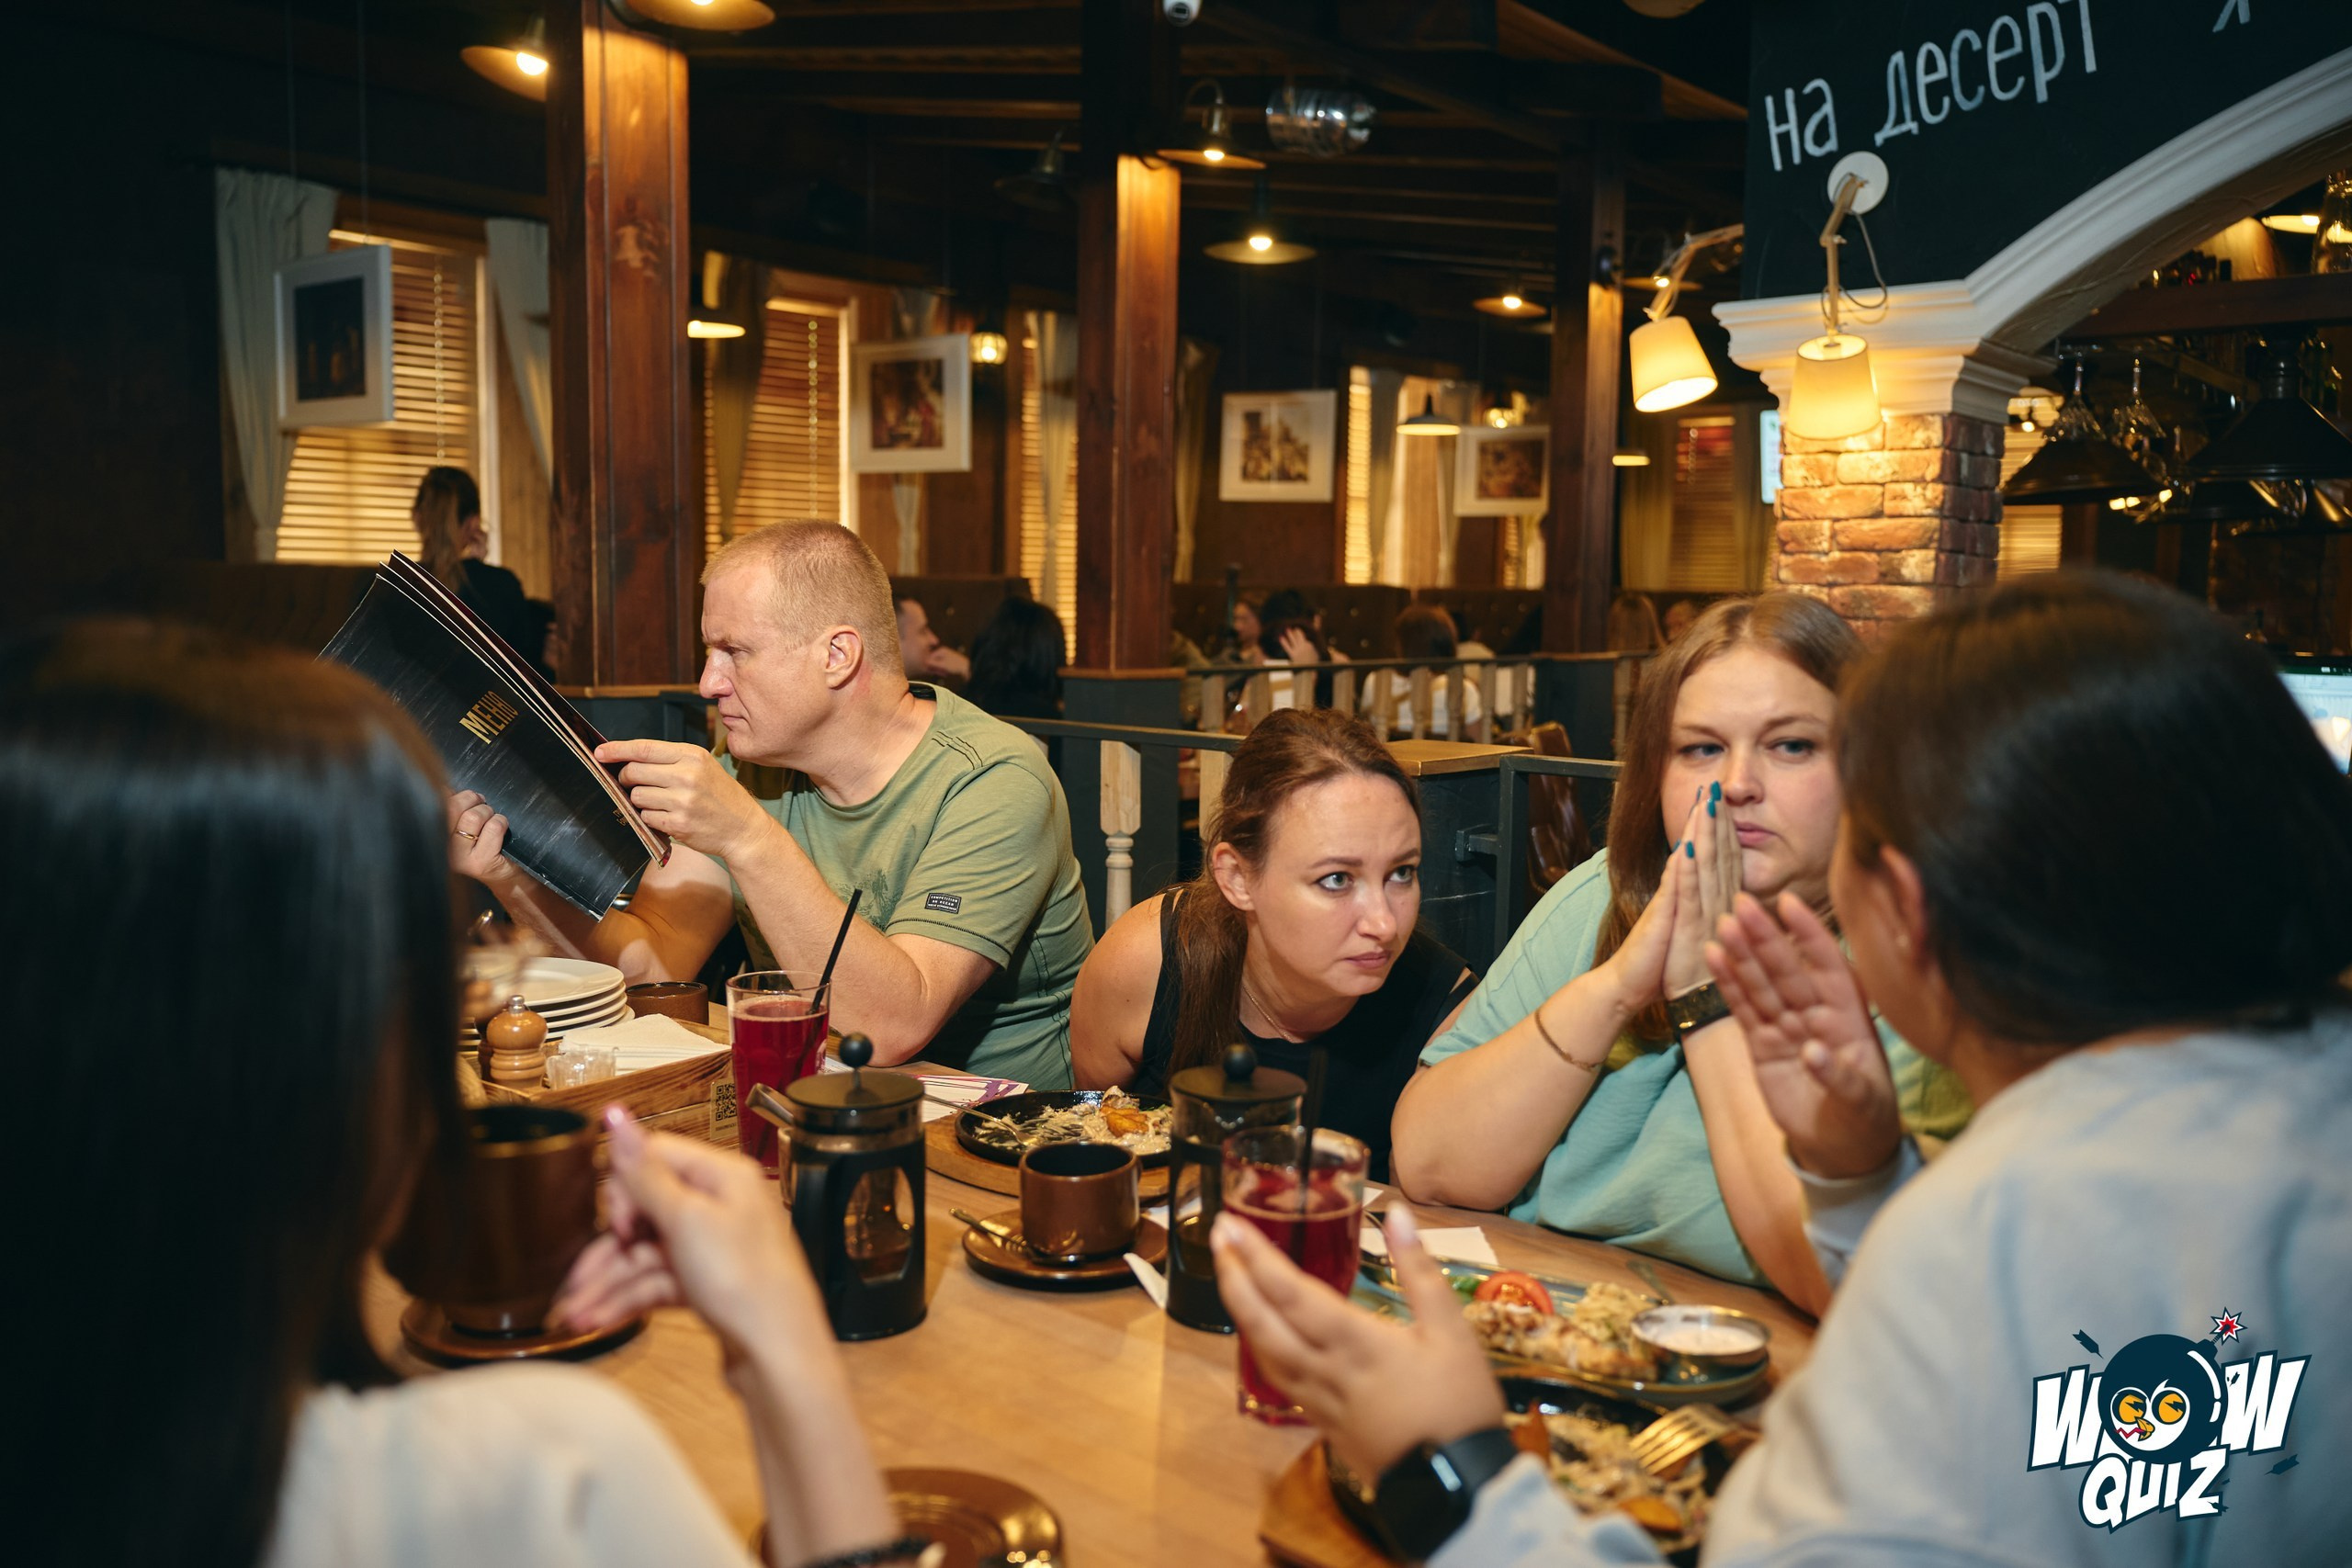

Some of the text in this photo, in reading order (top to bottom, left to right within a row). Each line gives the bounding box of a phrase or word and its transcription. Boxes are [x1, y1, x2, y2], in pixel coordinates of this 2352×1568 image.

[1765, 0, 2098, 172] на десерт
[458, 690, 519, 745] МЕНЮ
